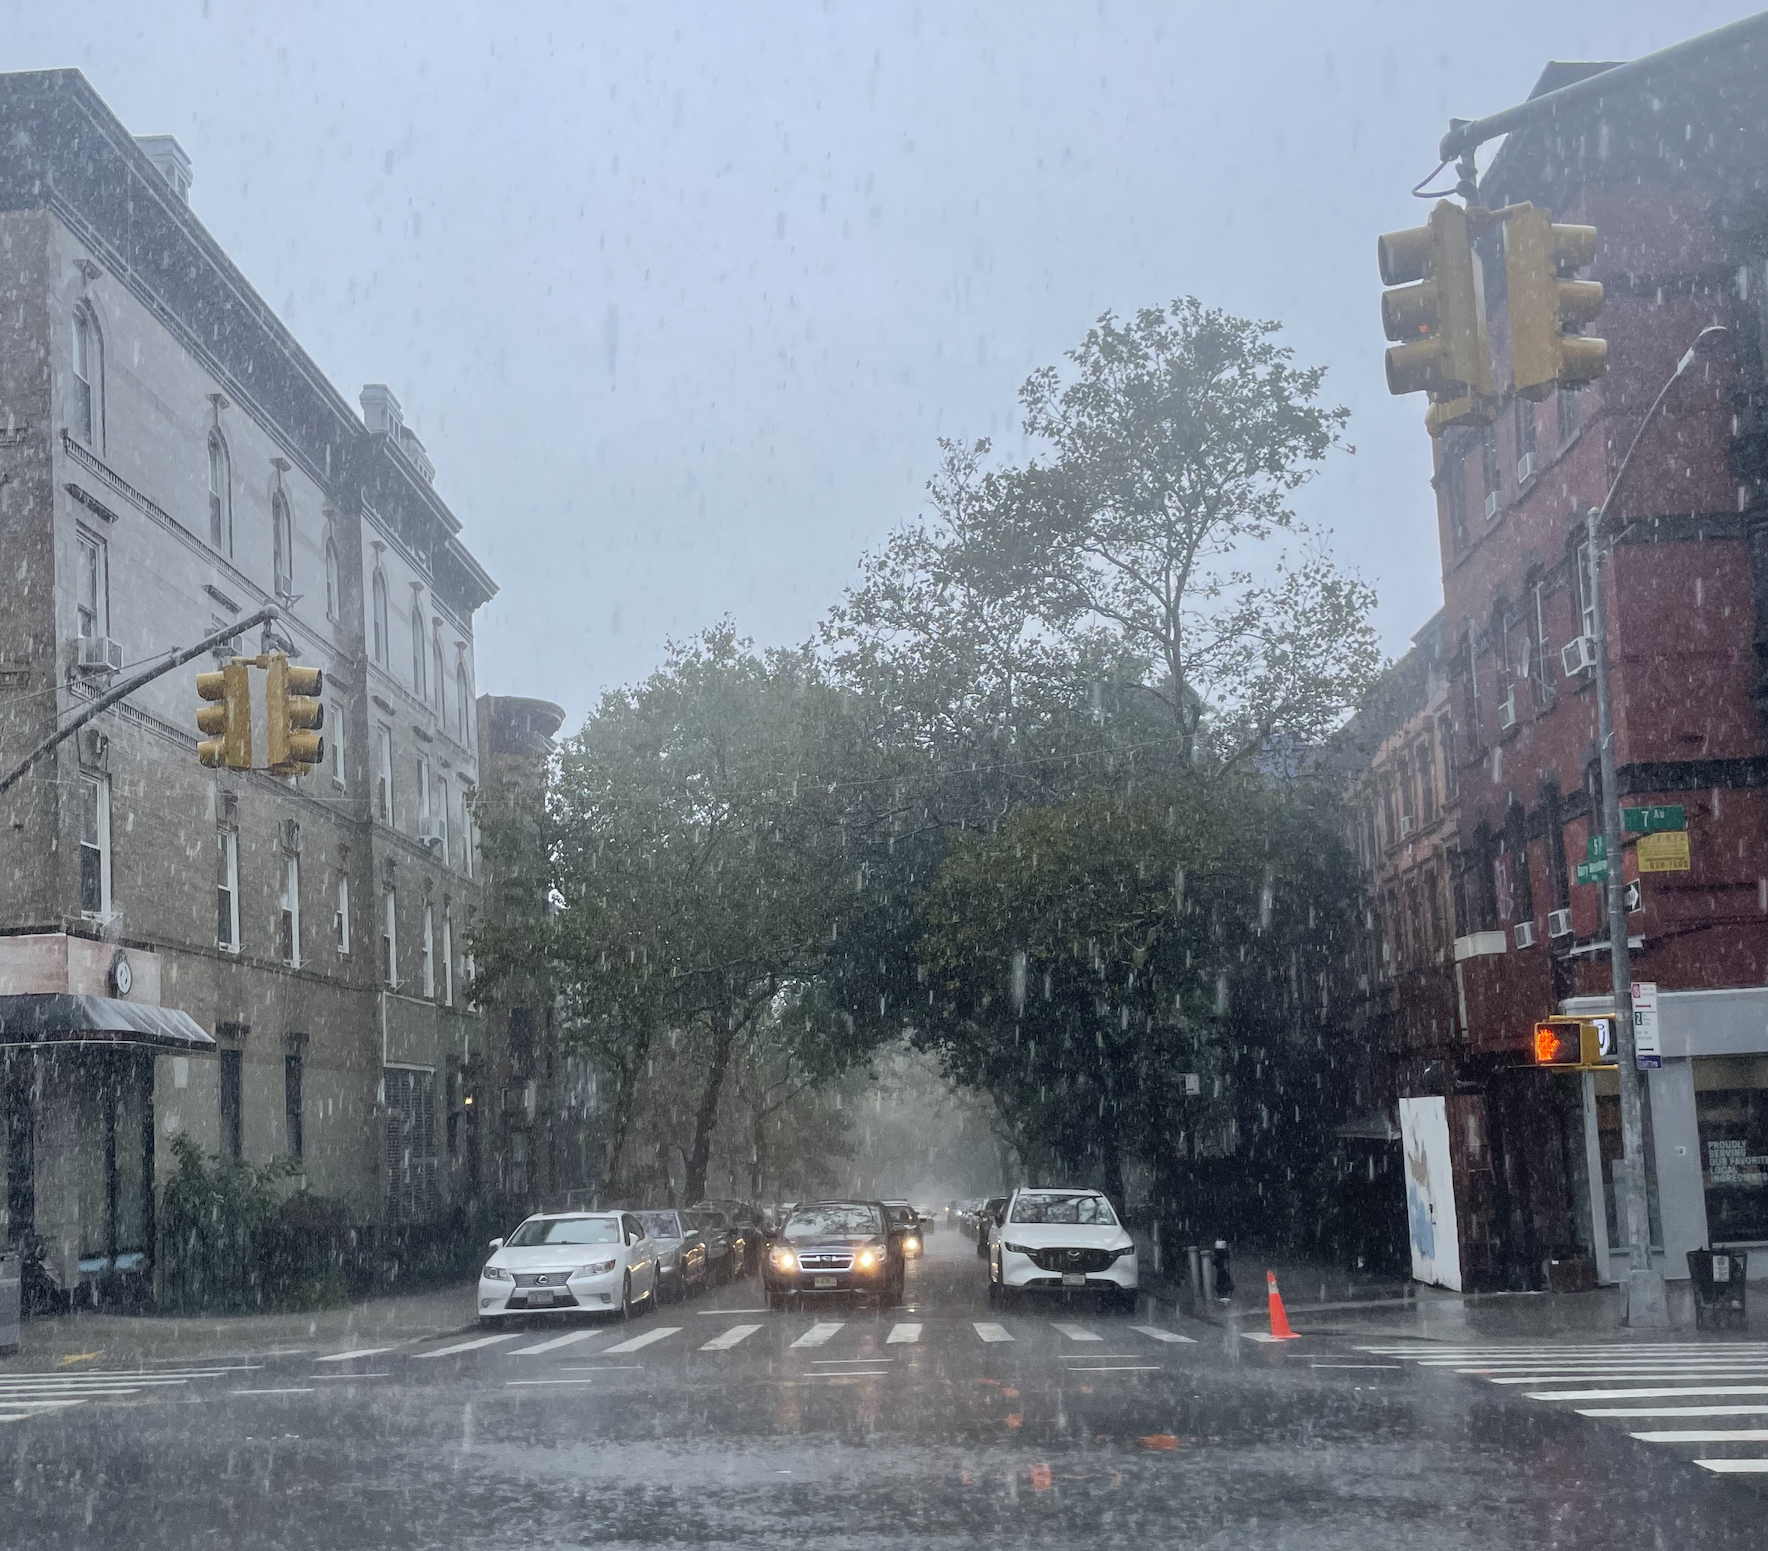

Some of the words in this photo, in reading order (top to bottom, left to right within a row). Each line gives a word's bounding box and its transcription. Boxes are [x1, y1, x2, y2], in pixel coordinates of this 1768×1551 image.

[1641, 810, 1649, 827] 7
[1707, 1139, 1747, 1150] PROUDLY
[1708, 1148, 1747, 1158] SERVING
[1709, 1157, 1728, 1167] OUR
[1710, 1165, 1738, 1175] LOCAL
